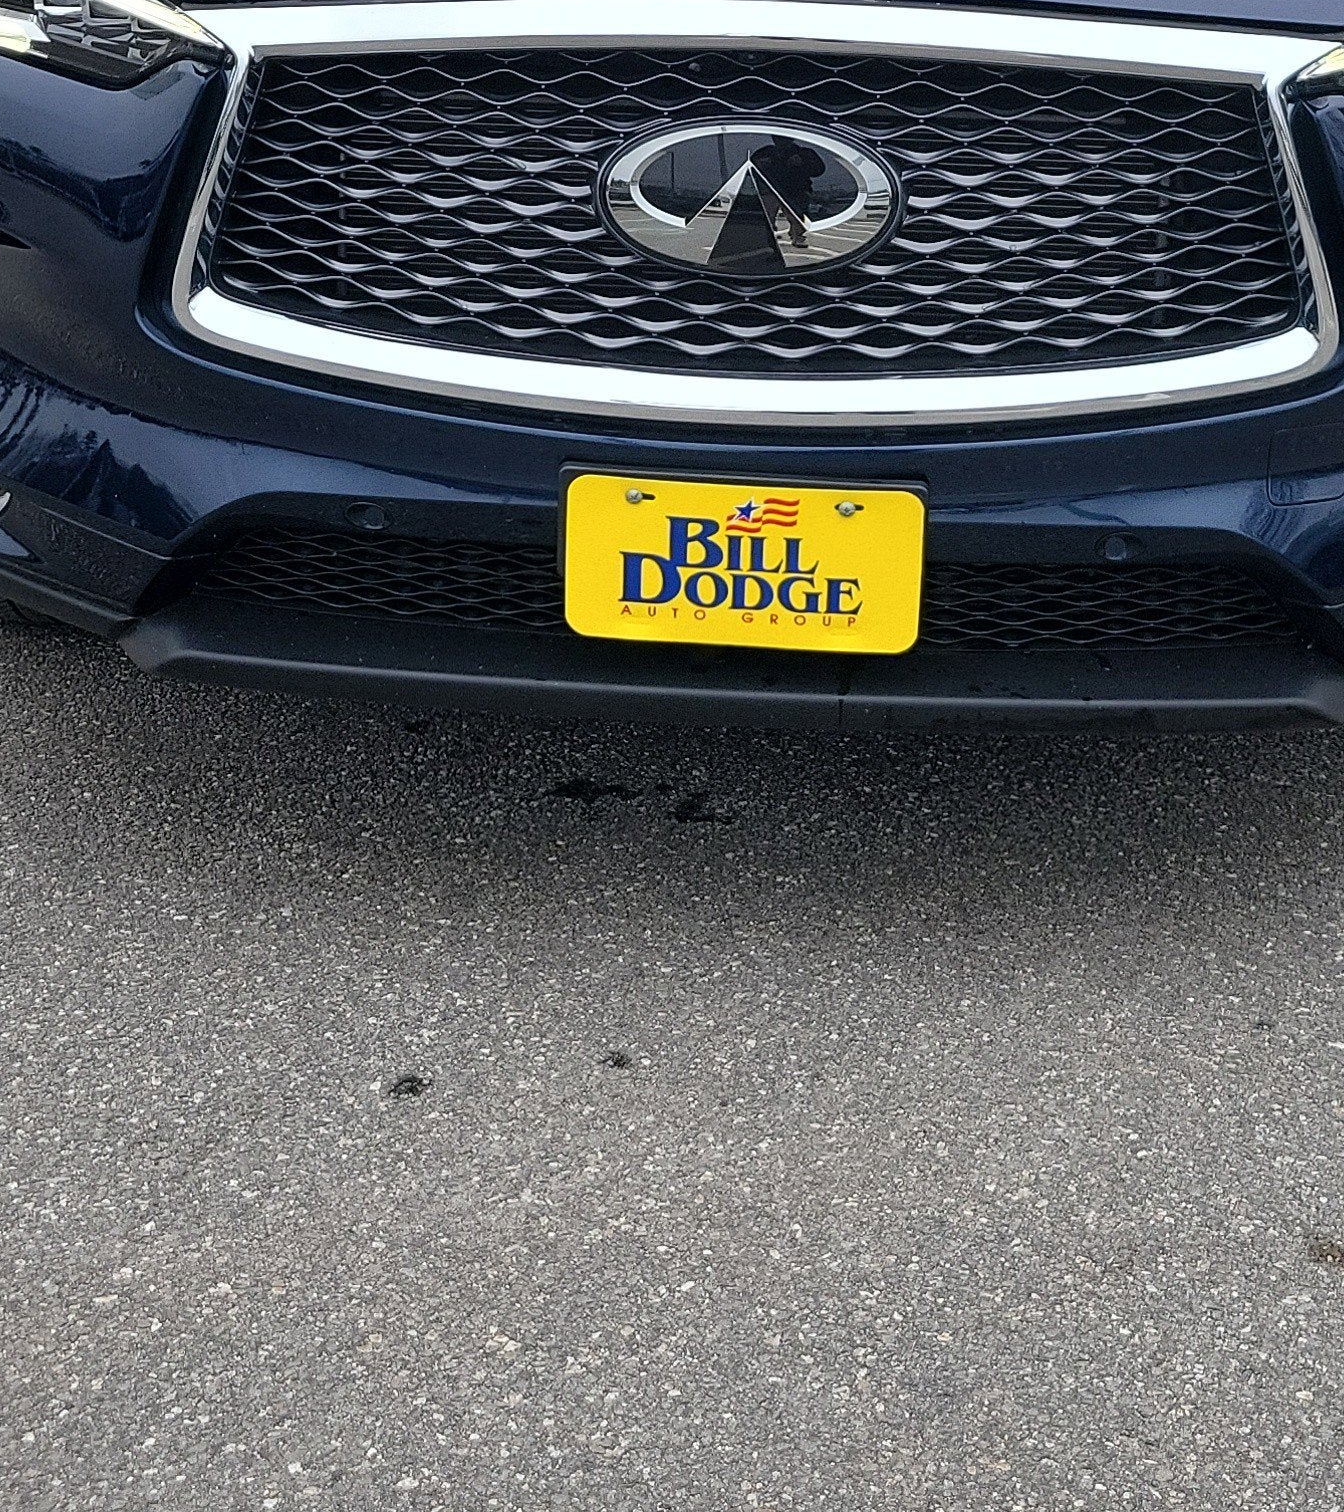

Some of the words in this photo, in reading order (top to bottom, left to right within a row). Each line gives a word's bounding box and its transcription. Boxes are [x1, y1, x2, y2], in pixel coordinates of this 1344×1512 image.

[666, 515, 819, 574] BILL
[618, 551, 862, 615] DODGE
[620, 604, 706, 621] AUTO
[742, 612, 858, 627] GROUP
